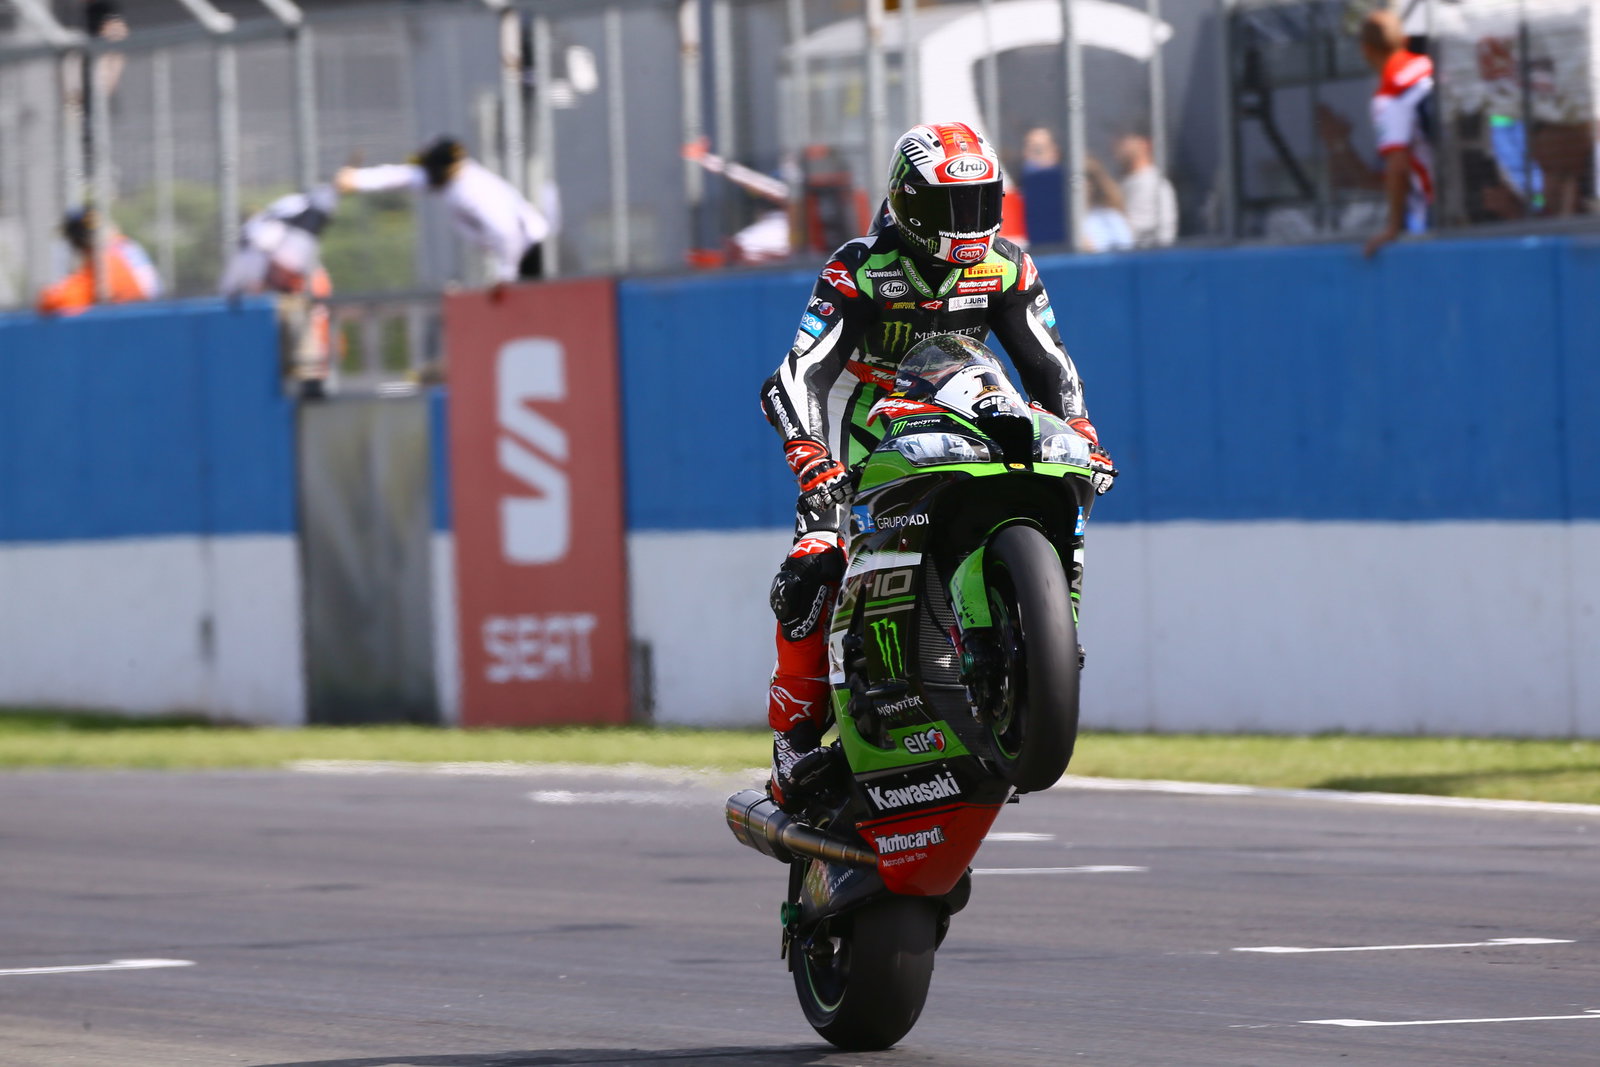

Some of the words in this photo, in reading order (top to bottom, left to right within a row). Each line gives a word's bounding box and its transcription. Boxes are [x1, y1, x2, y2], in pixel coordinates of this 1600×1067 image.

[956, 160, 984, 174] Arai
[960, 250, 980, 259] PATA
[865, 269, 904, 278] Kawasaki
[967, 264, 1004, 275] PIRELLI
[884, 283, 906, 293] Arai
[964, 297, 987, 305] J.JUAN
[767, 385, 801, 440] Kawasaki
[483, 612, 597, 683] SEAT
[876, 695, 924, 717] MONSTER
[904, 733, 930, 753] elf
[867, 771, 962, 811] Kawasaki
[875, 827, 940, 854] Motocard
